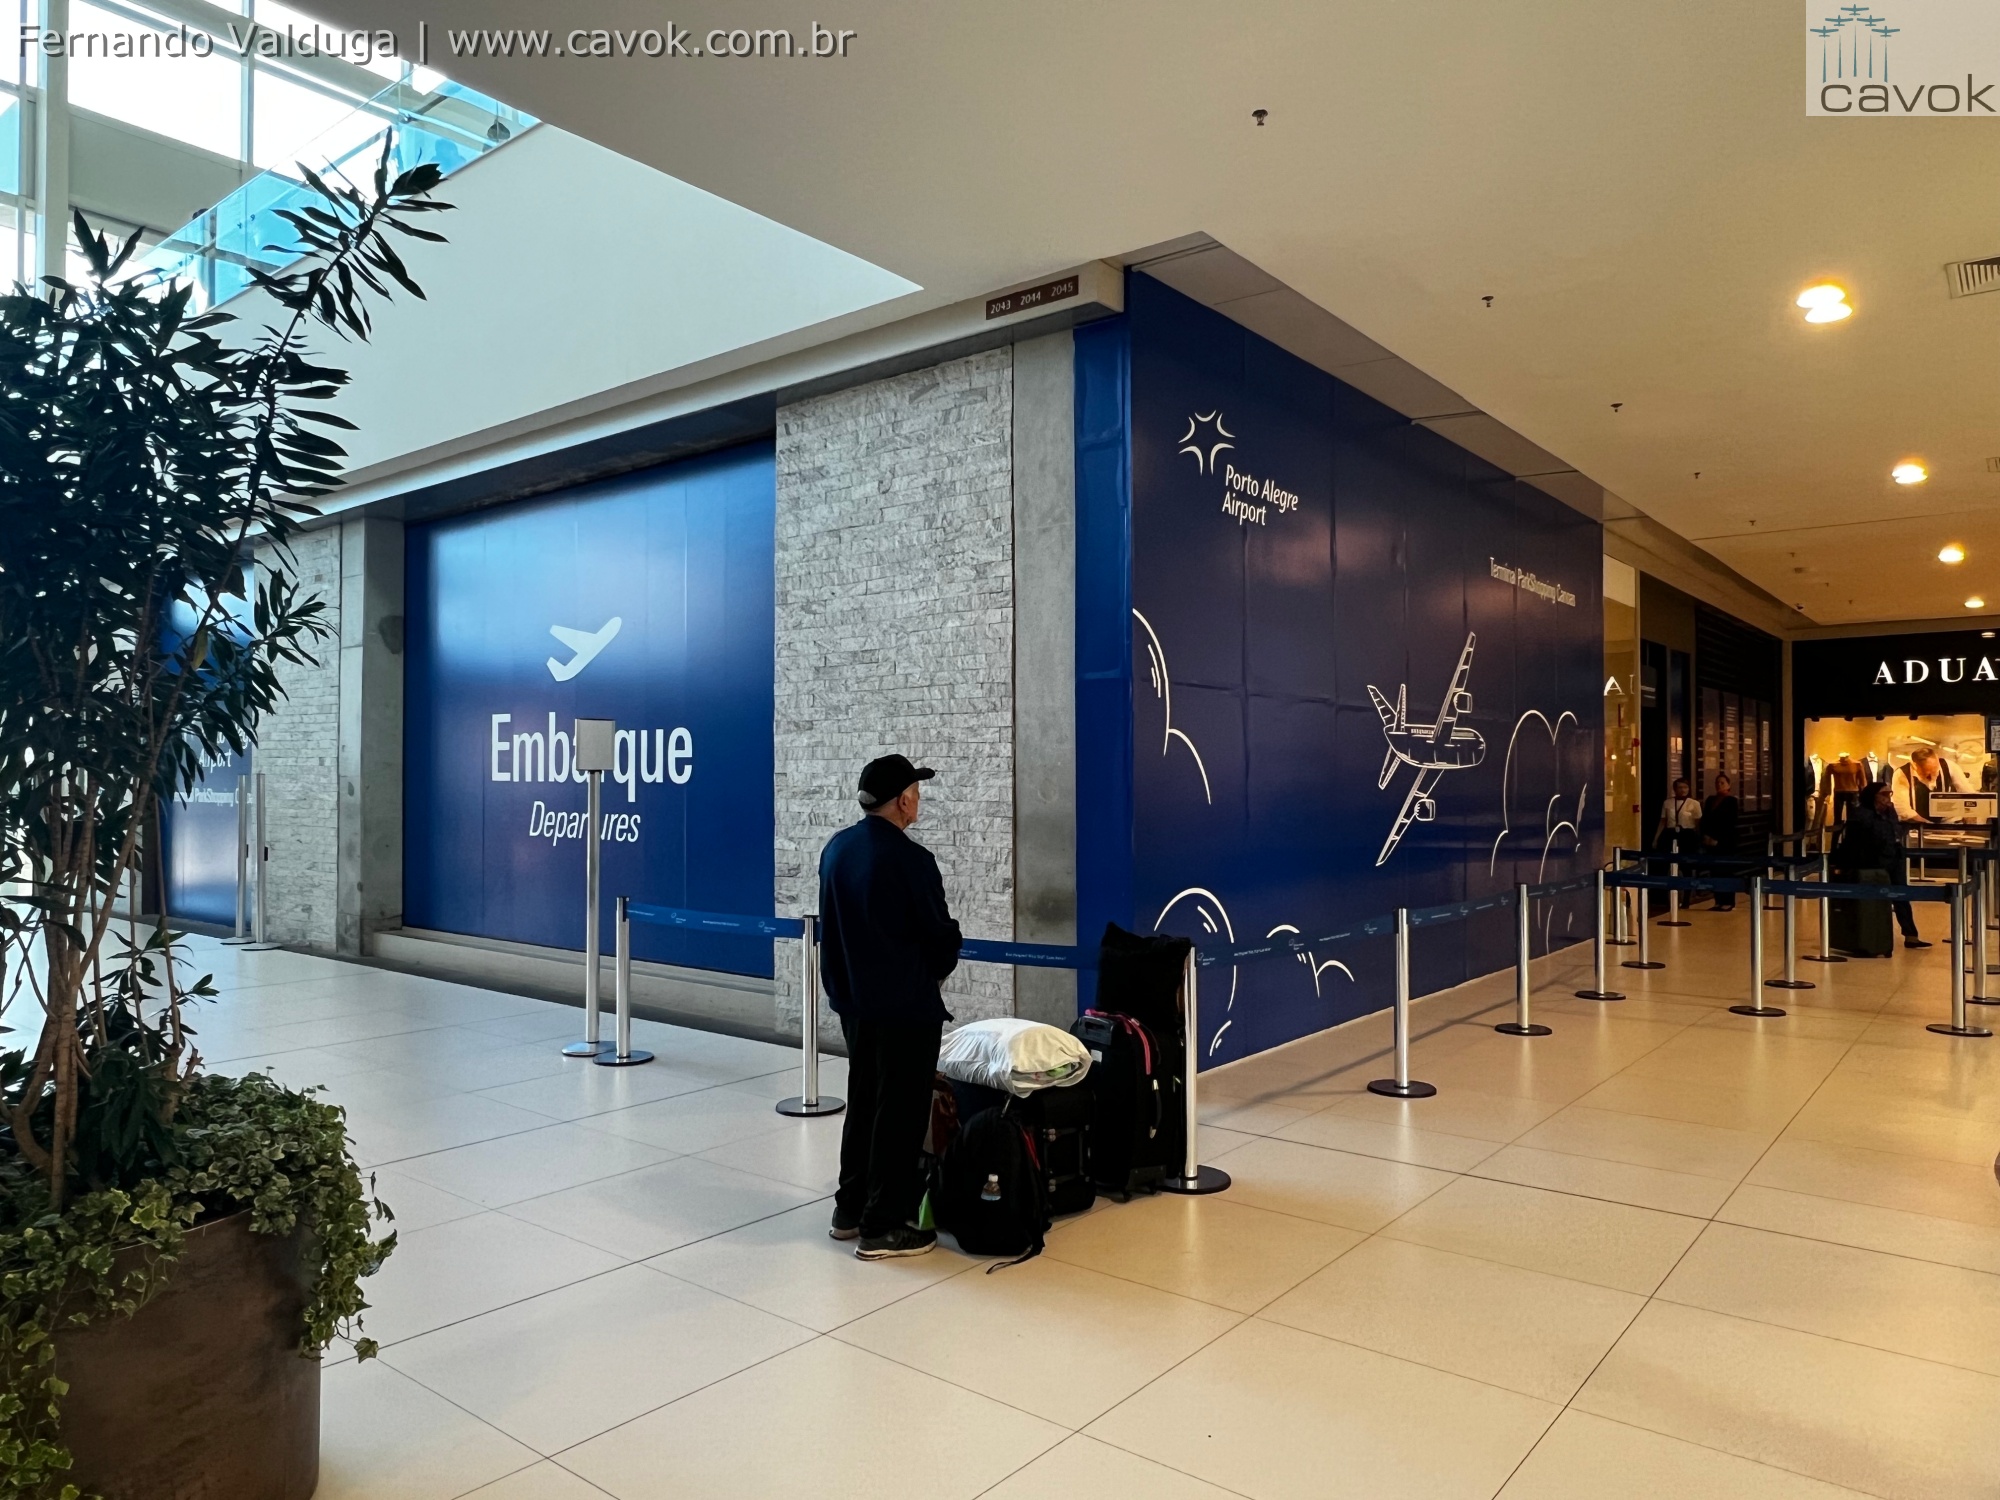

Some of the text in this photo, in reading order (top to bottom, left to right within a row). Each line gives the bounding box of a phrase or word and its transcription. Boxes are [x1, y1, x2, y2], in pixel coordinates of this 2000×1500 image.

[990, 281, 1073, 314] 2043 2044 2045
[1222, 491, 1267, 526] Airport
[1225, 464, 1298, 513] Porto Alegre
[1872, 656, 2000, 685] ADUA
[491, 712, 693, 803] Embque
[529, 801, 641, 846] Deparures
